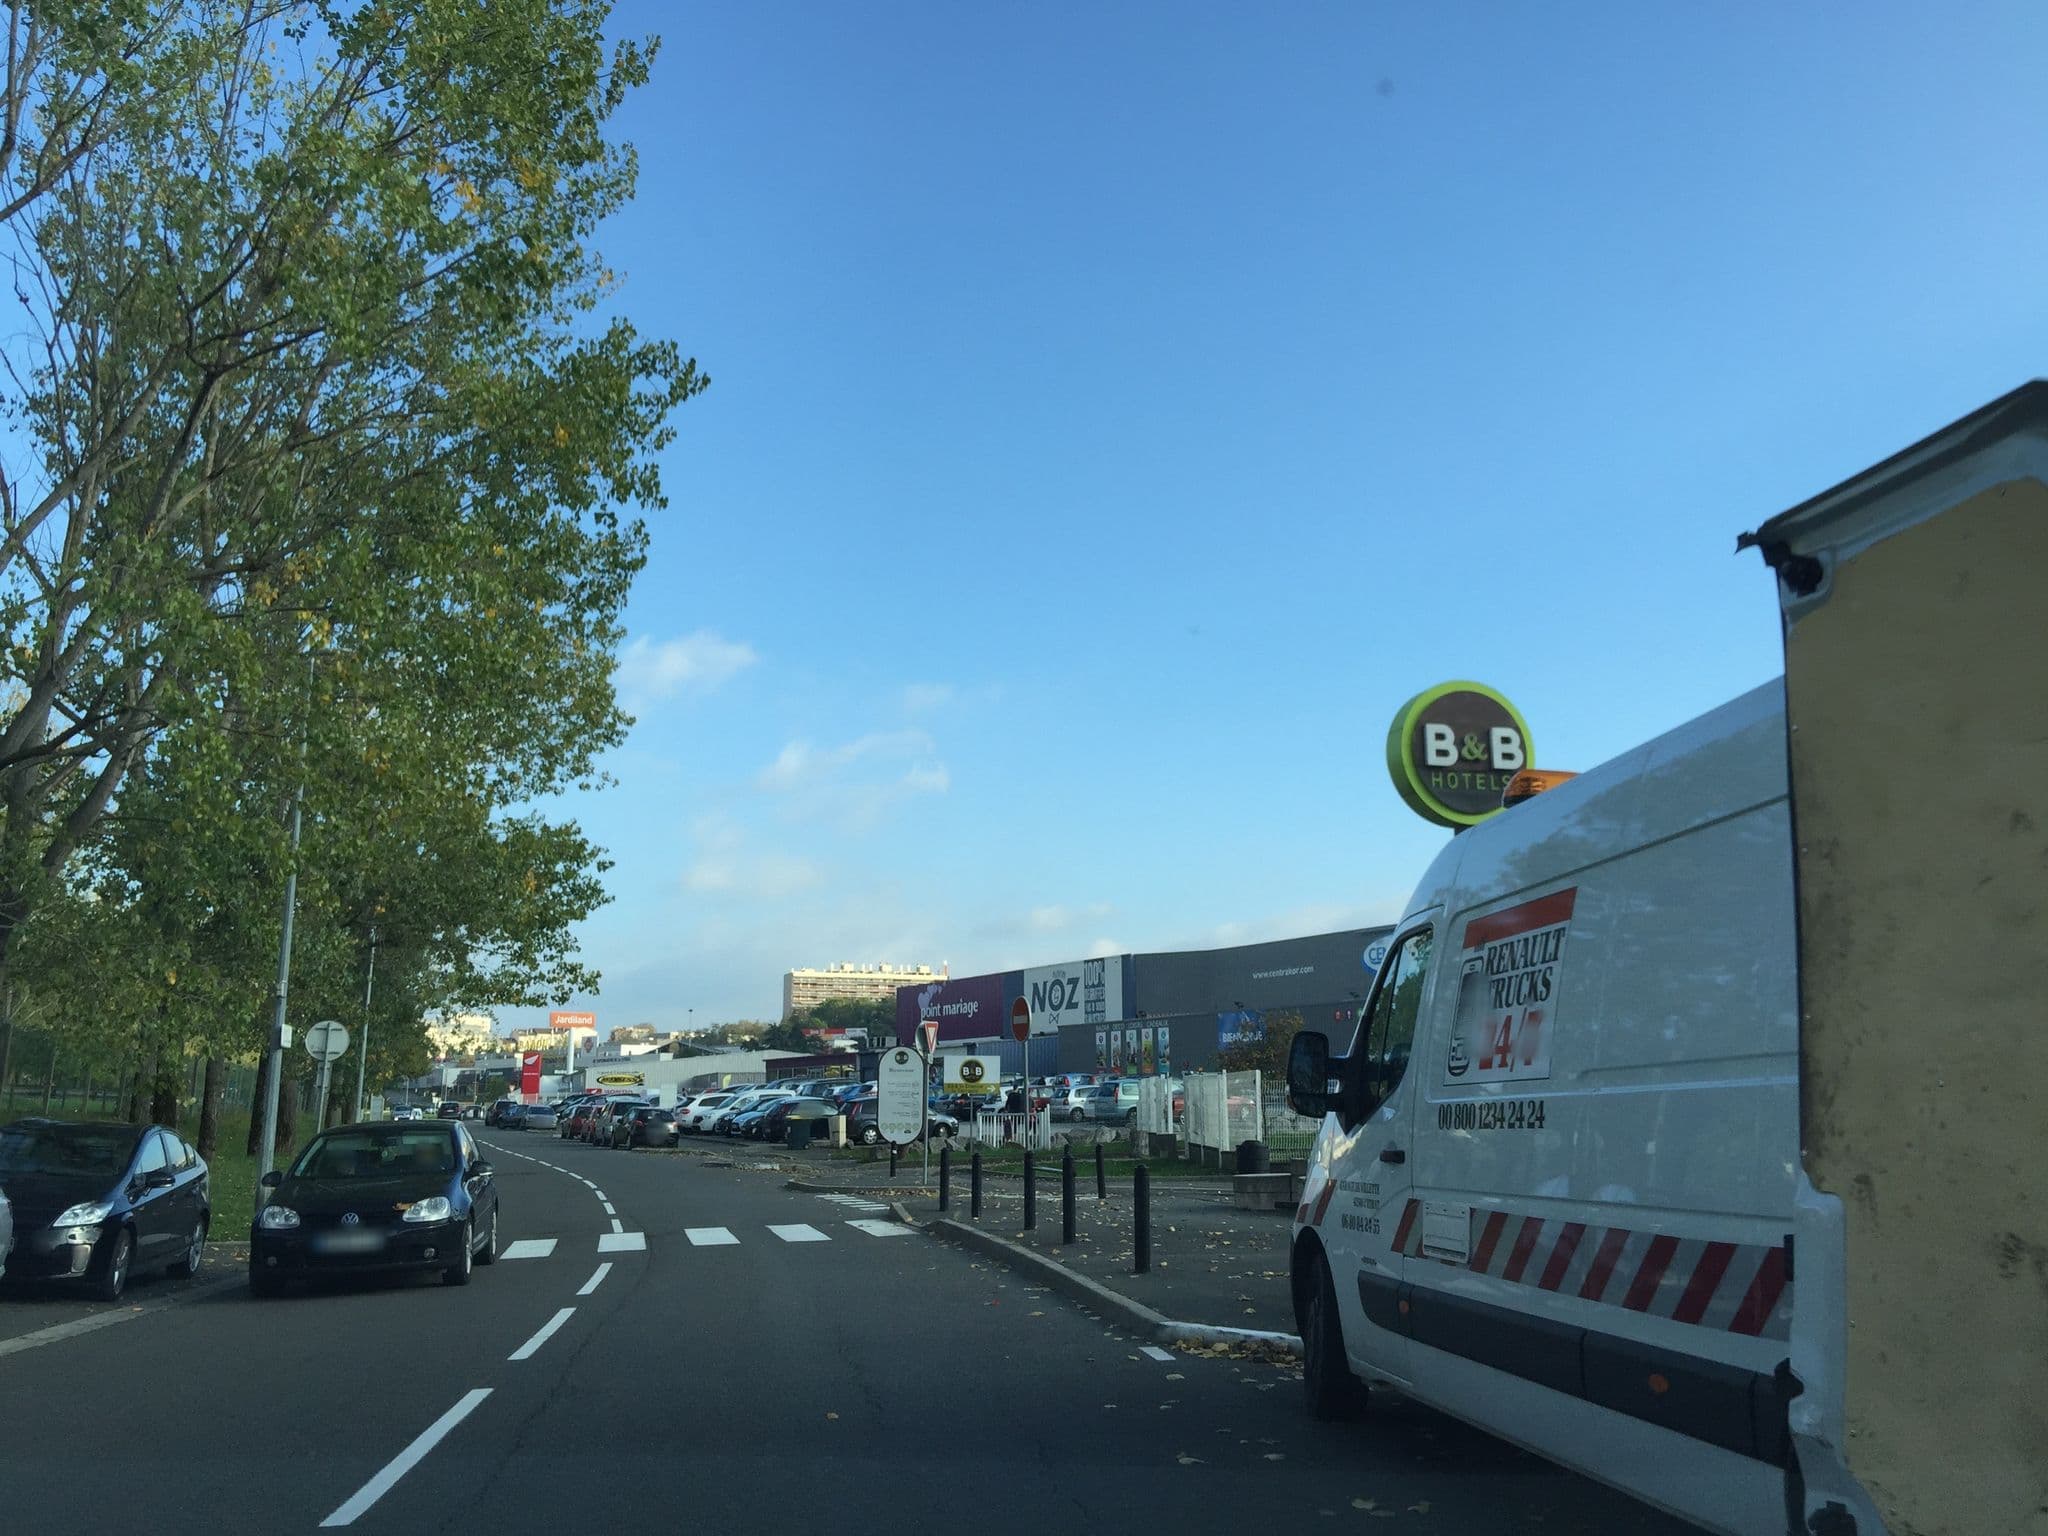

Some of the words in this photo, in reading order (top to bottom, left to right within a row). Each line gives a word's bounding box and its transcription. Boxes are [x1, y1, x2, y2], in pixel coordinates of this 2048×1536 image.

[1424, 722, 1525, 770] B&B
[1486, 927, 1567, 975] RENAULT
[1032, 977, 1080, 1014] NOZ
[1490, 966, 1554, 1009] TRUCKS
[555, 1015, 593, 1025] Jardiland
[920, 1003, 942, 1021] point
[942, 998, 979, 1018] mariage
[1438, 1104, 1452, 1130] 00
[1454, 1103, 1476, 1130] 800
[1478, 1102, 1506, 1130] 1234
[1507, 1101, 1526, 1130] 24
[1527, 1100, 1546, 1129] 24
